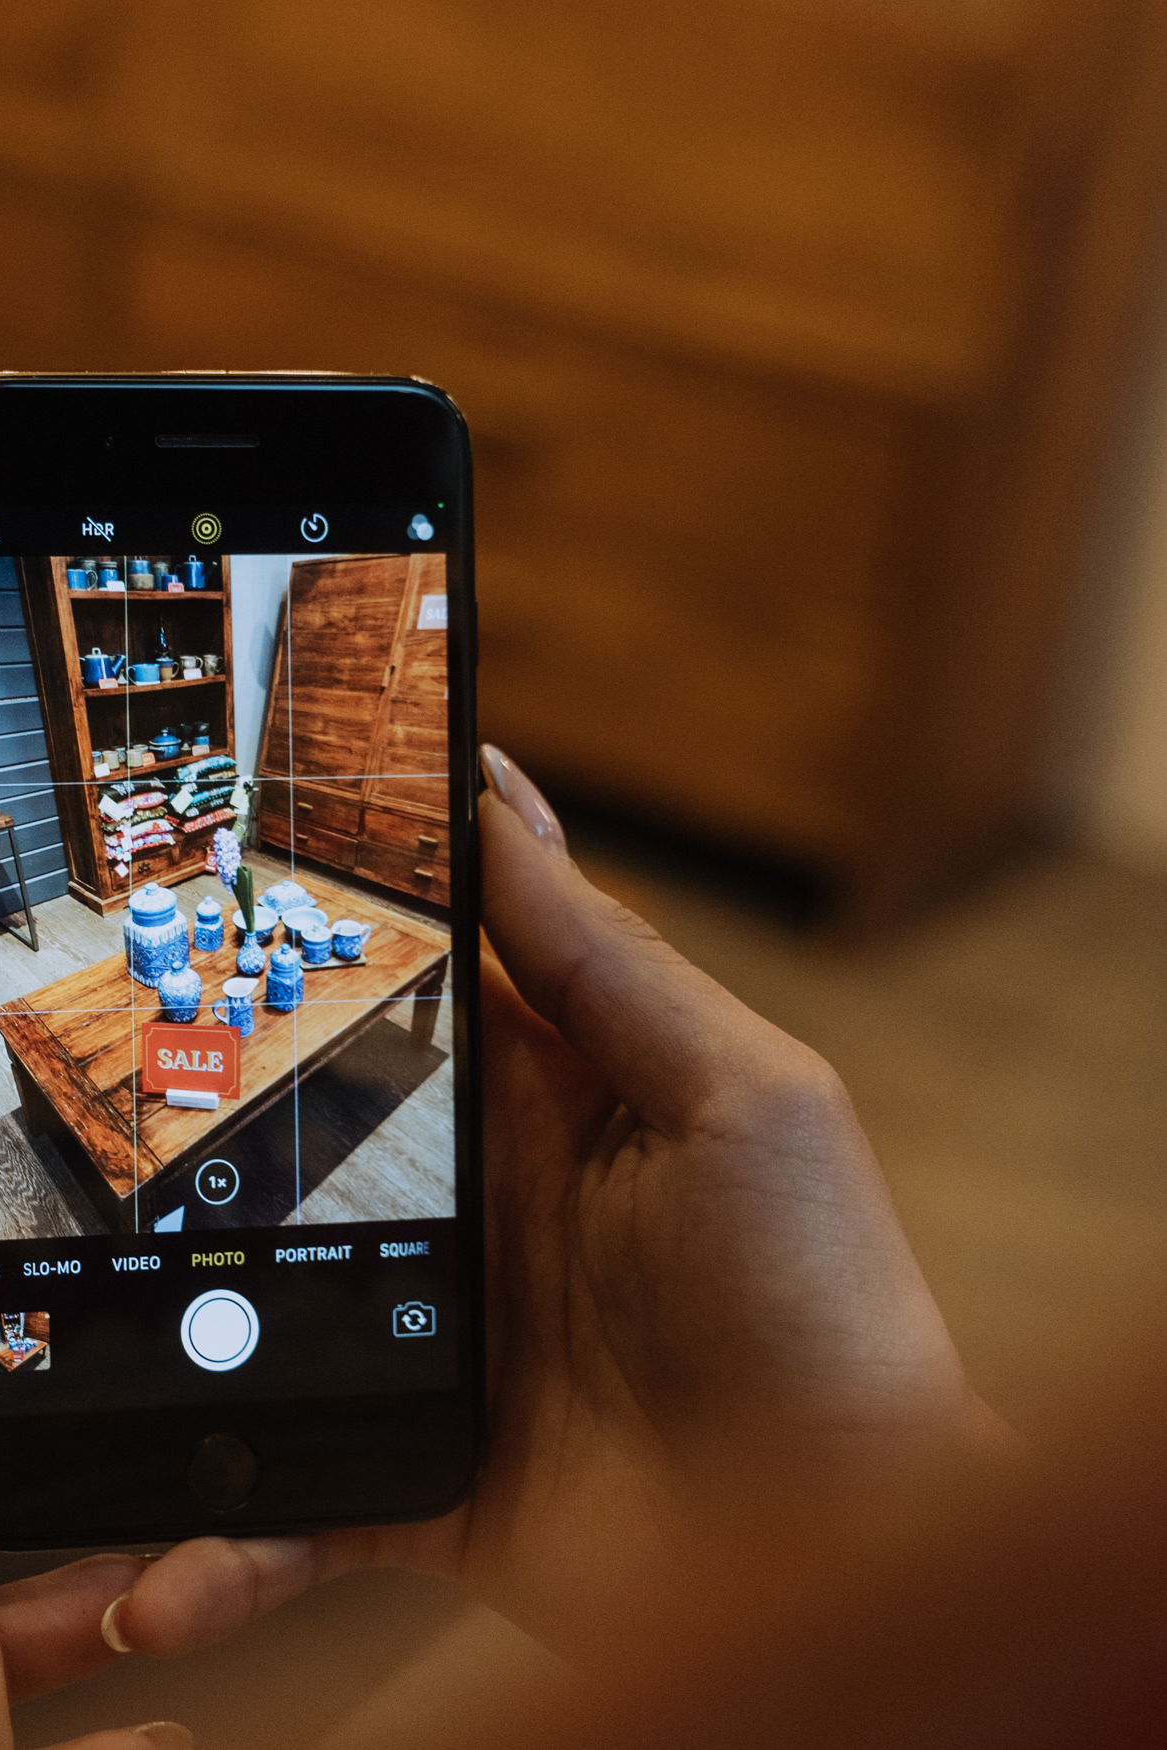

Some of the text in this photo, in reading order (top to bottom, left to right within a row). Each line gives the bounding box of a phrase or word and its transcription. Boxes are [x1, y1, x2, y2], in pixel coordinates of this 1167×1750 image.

[82, 522, 115, 537] HDR
[156, 1048, 224, 1073] SALE
[23, 1259, 82, 1276] SLO-MO
[112, 1255, 162, 1271] VIDEO
[191, 1251, 246, 1267] PHOTO
[275, 1245, 353, 1263] PORTRAIT
[379, 1241, 431, 1258] SQUARE
